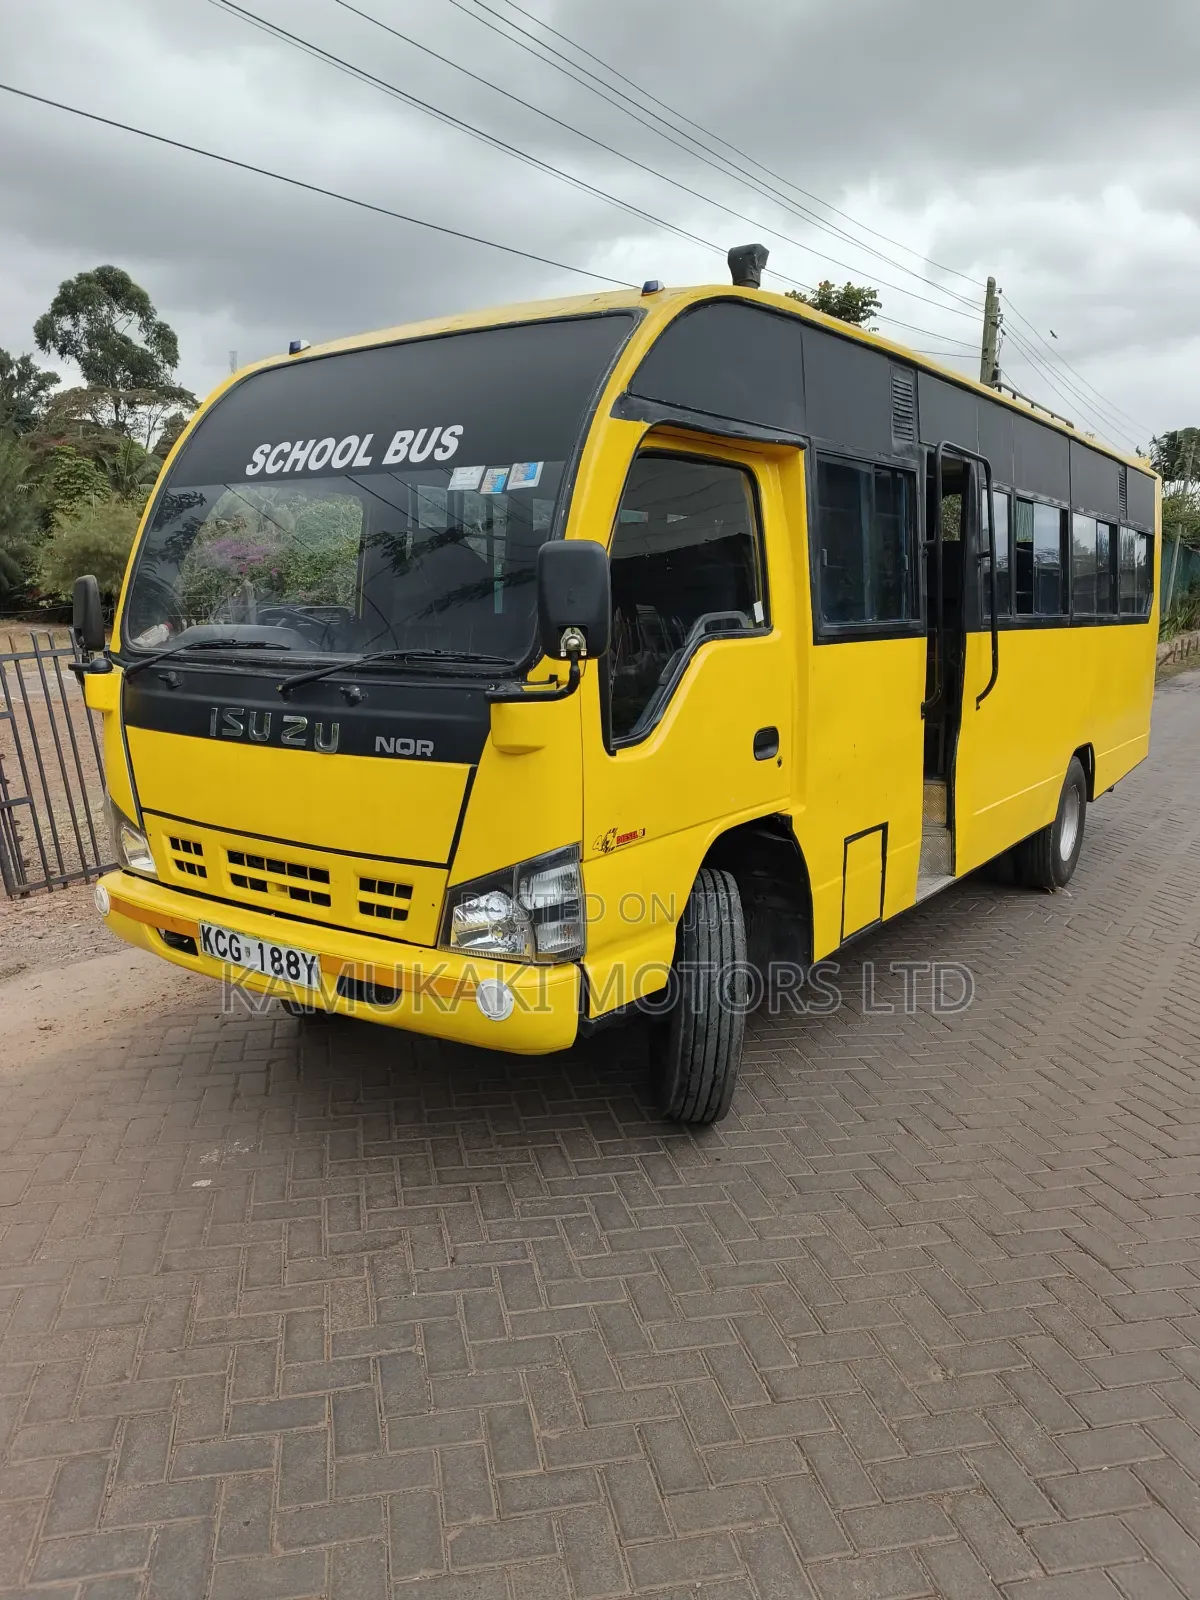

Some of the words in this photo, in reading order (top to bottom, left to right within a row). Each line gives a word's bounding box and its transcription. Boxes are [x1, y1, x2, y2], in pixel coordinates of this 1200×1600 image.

[246, 433, 374, 475] SCHOOL
[382, 425, 463, 464] BUS
[209, 707, 340, 754] ISUZU
[375, 736, 434, 757] NQR
[616, 830, 639, 845] DIESEL
[201, 924, 242, 962] KCG
[258, 942, 316, 985] 188Y
